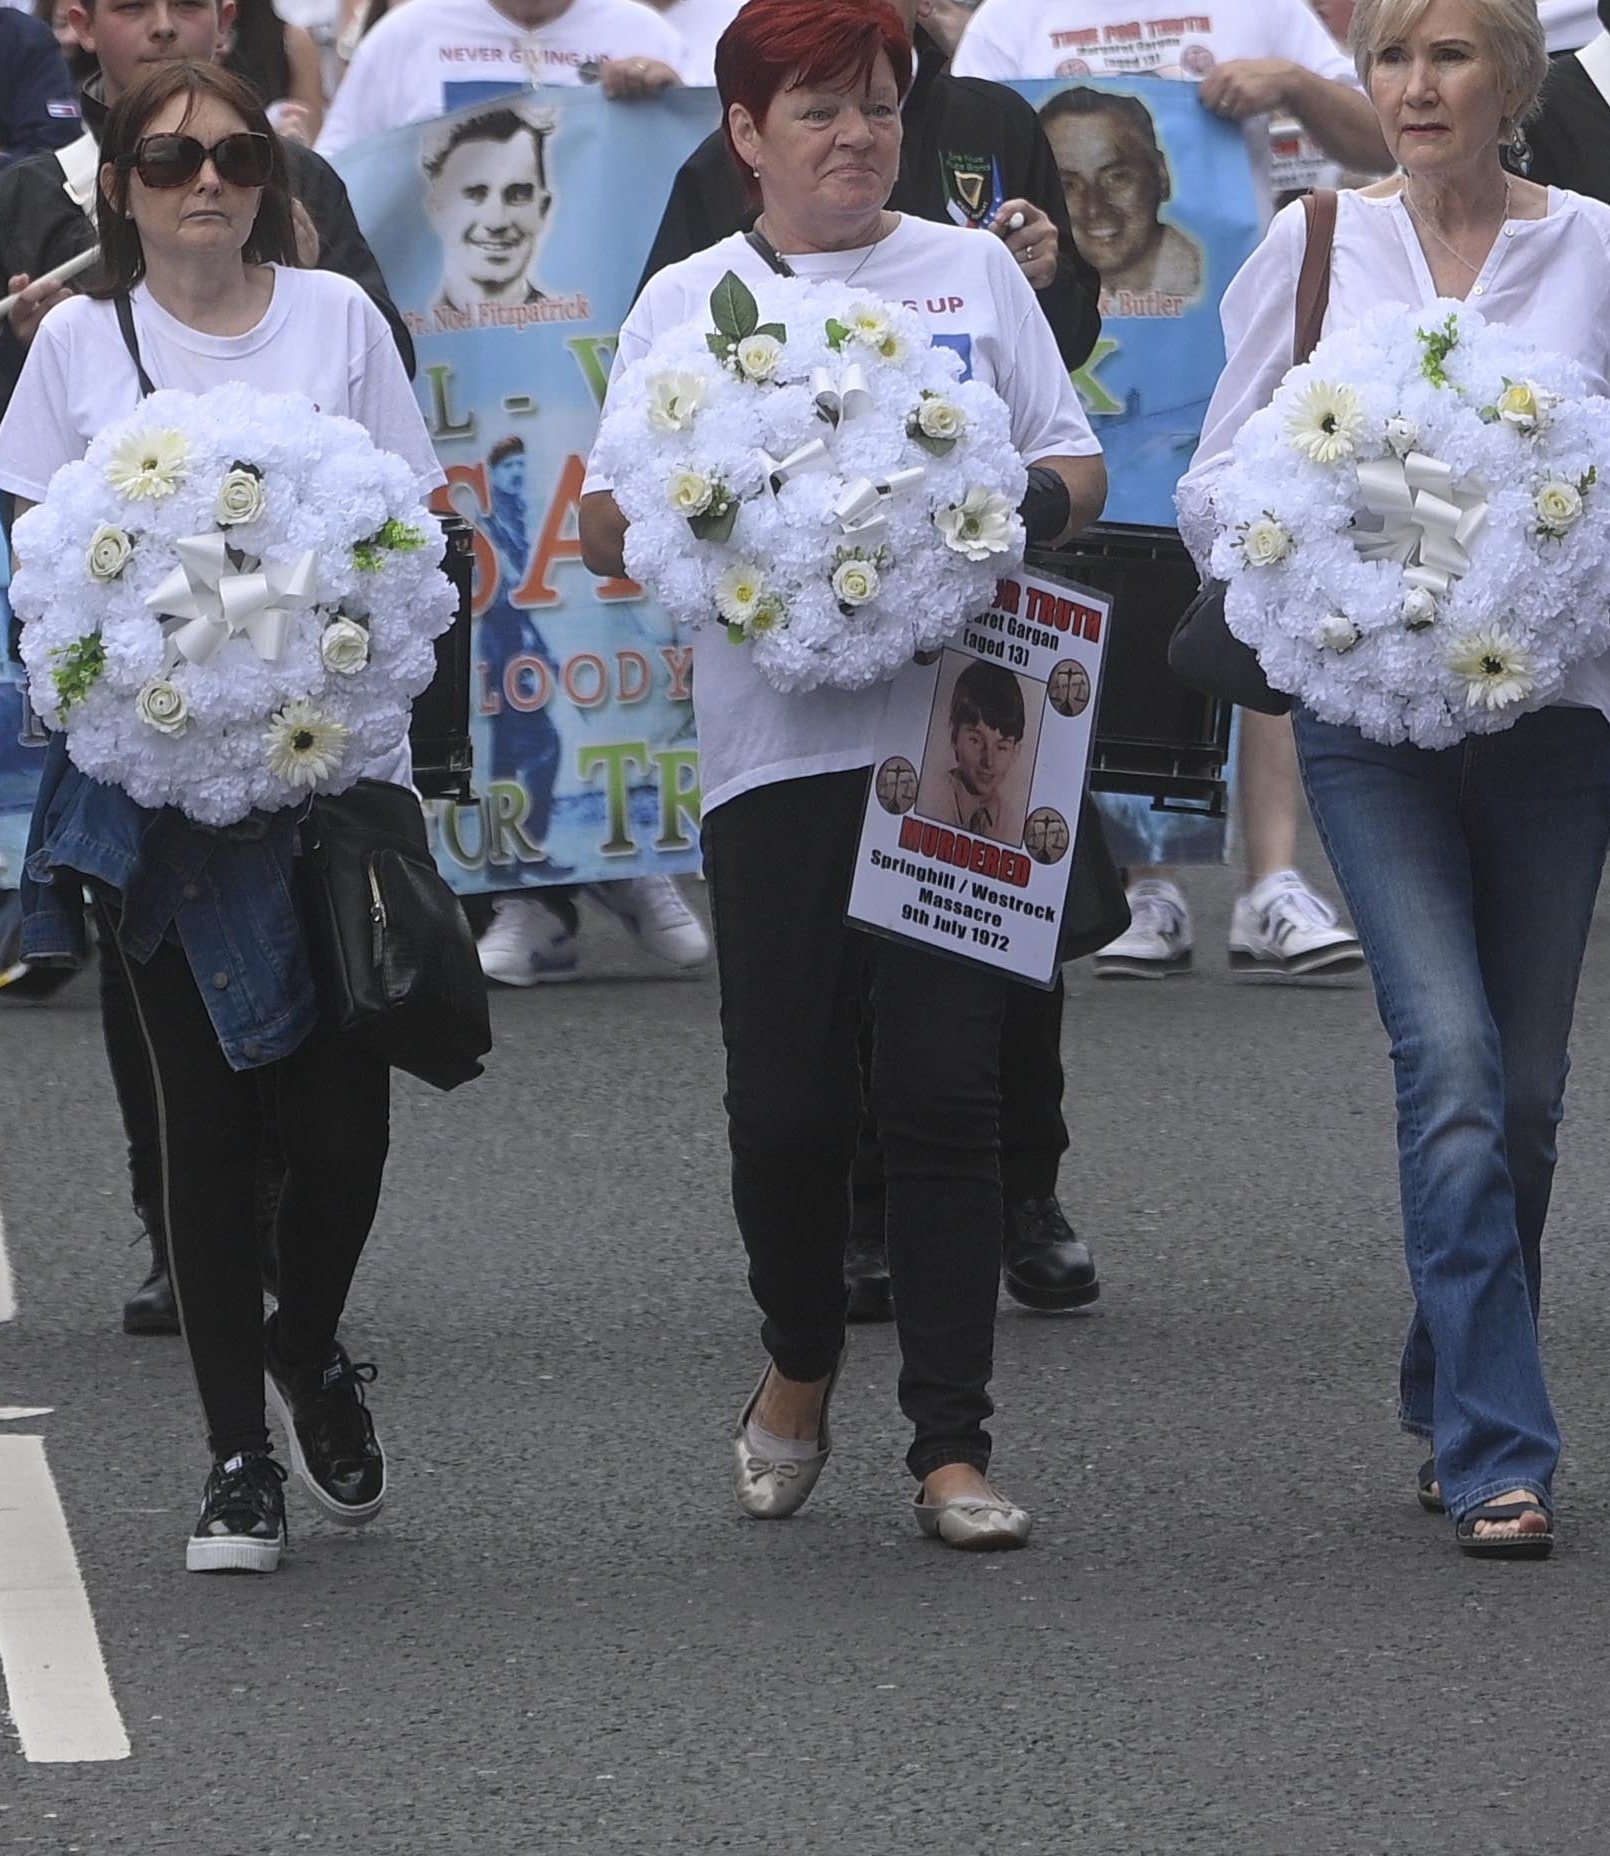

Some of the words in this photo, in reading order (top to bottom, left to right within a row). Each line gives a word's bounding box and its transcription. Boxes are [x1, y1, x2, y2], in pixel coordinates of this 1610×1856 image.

[440, 48, 503, 63] NEVER
[433, 304, 471, 331] Noel
[478, 292, 590, 331] Fitzpatrick
[927, 296, 965, 314] UP
[1119, 291, 1183, 317] Butler
[1007, 616, 1059, 651] Gargan
[1026, 586, 1102, 644] TRUTH
[963, 628, 1005, 658] (aged
[1008, 644, 1030, 667] 13)
[477, 646, 694, 716] LOODY
[898, 815, 1032, 889] MURDERED
[870, 849, 956, 891] Springhill
[971, 881, 1056, 923] Westrock
[918, 887, 1002, 928] Massacre
[901, 904, 930, 926] 9th
[933, 915, 967, 940] July
[971, 927, 1011, 952] 1972
